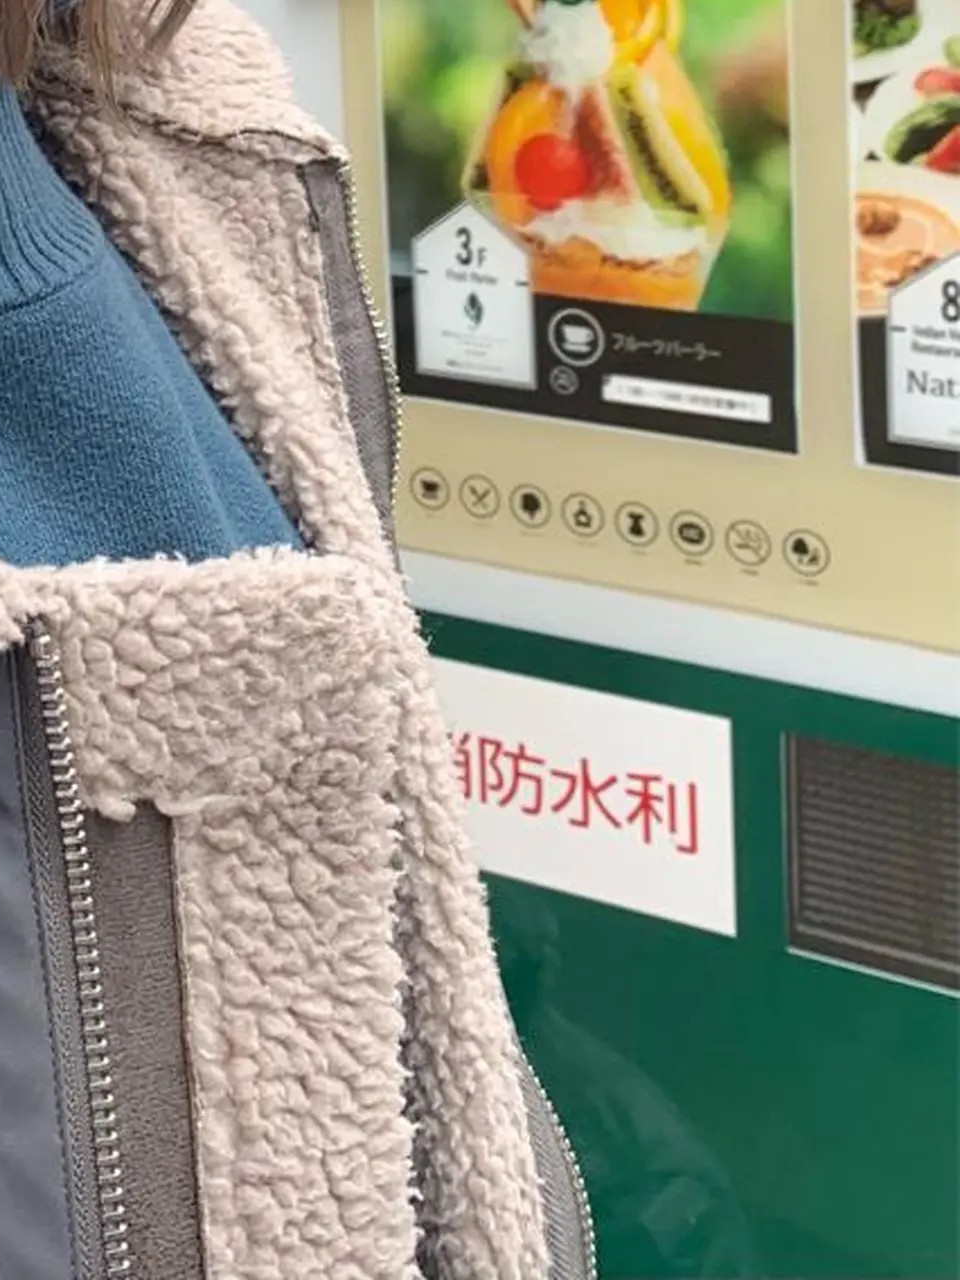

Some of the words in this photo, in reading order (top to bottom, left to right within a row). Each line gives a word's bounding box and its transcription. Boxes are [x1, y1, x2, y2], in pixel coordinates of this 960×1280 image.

[611, 331, 723, 362] フルーツパーラー
